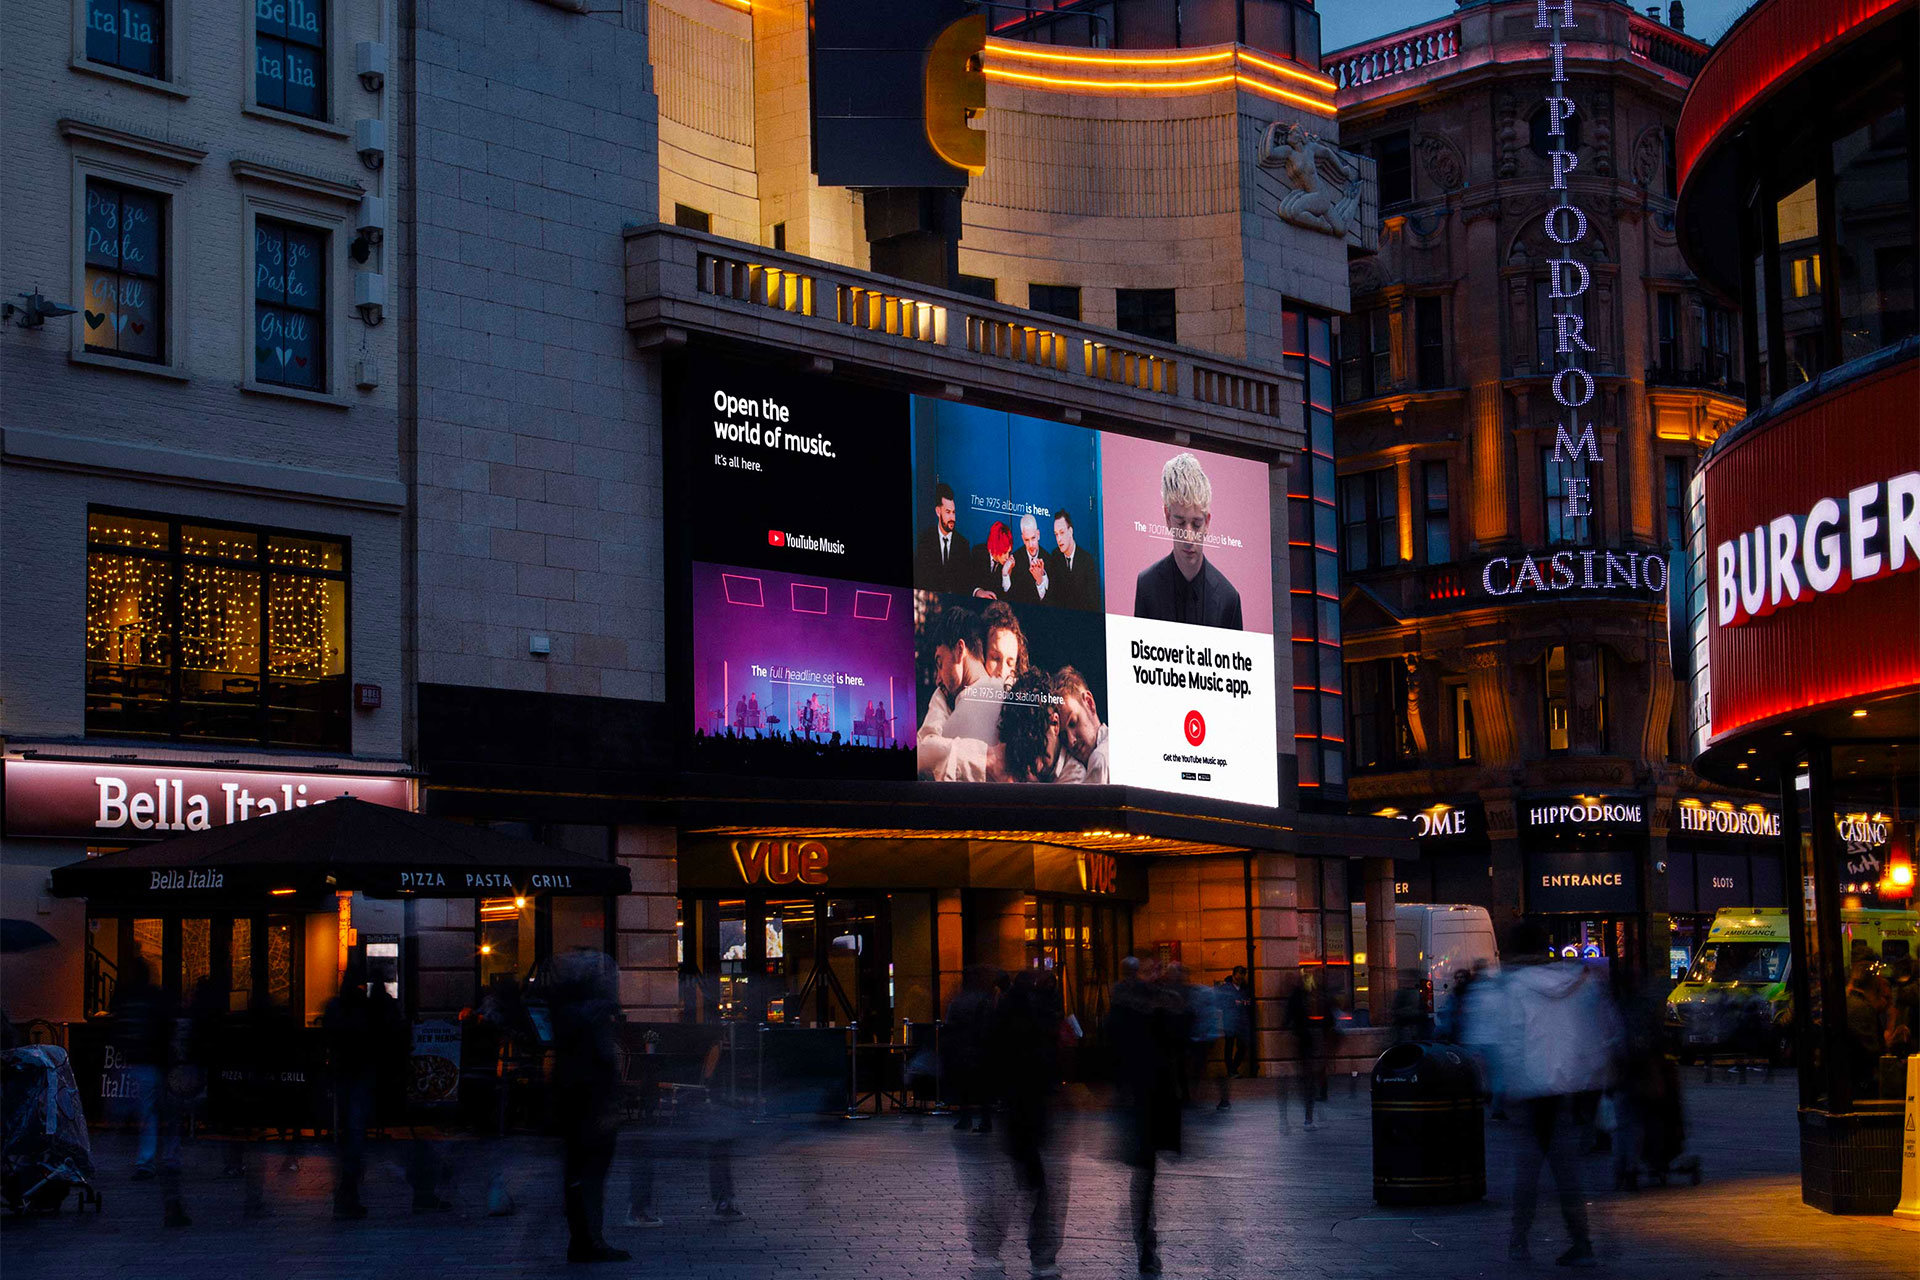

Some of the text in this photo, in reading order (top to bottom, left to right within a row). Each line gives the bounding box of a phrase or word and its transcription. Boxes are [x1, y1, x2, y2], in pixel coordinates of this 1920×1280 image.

[86, 190, 148, 231] Pizza
[86, 228, 145, 263] Pasta
[255, 227, 311, 267] Pizza
[91, 275, 145, 309] Grill
[255, 264, 308, 297] Pasta
[260, 311, 309, 341] Grill
[714, 390, 790, 423] Open the
[714, 421, 836, 458] world of music.
[728, 456, 740, 469] all
[741, 457, 763, 472] here.
[970, 494, 1051, 517] The 1975 album is here.
[785, 532, 845, 555] YouTube Music
[1134, 521, 1147, 533] The
[1221, 534, 1227, 546] is
[1227, 536, 1243, 548] here.
[1716, 470, 1920, 628] BURGER
[1482, 549, 1668, 596] CASINO
[1131, 639, 1252, 672] Discover it all on the
[751, 665, 865, 687] The full headline set is here.
[1133, 665, 1252, 699] YouTube Music app.
[979, 687, 994, 699] 1975
[995, 690, 1015, 701] radio
[1015, 691, 1040, 703] station
[1041, 692, 1047, 704] is
[1048, 693, 1066, 705] here.
[1173, 754, 1181, 763] the
[1181, 755, 1202, 764] YouTube
[1203, 757, 1216, 765] Music
[95, 776, 211, 832] Bella
[1529, 803, 1642, 826] HIPPODROME
[1679, 807, 1781, 836] HIPPODROME
[149, 868, 224, 890] Bella Italia
[401, 872, 446, 888] PIZZA
[465, 873, 513, 888] PASTA
[531, 874, 573, 889] GRILL
[1541, 873, 1622, 888] ENTRANCE
[1712, 876, 1734, 889] SLOTS
[280, 1071, 306, 1082] GRILL
